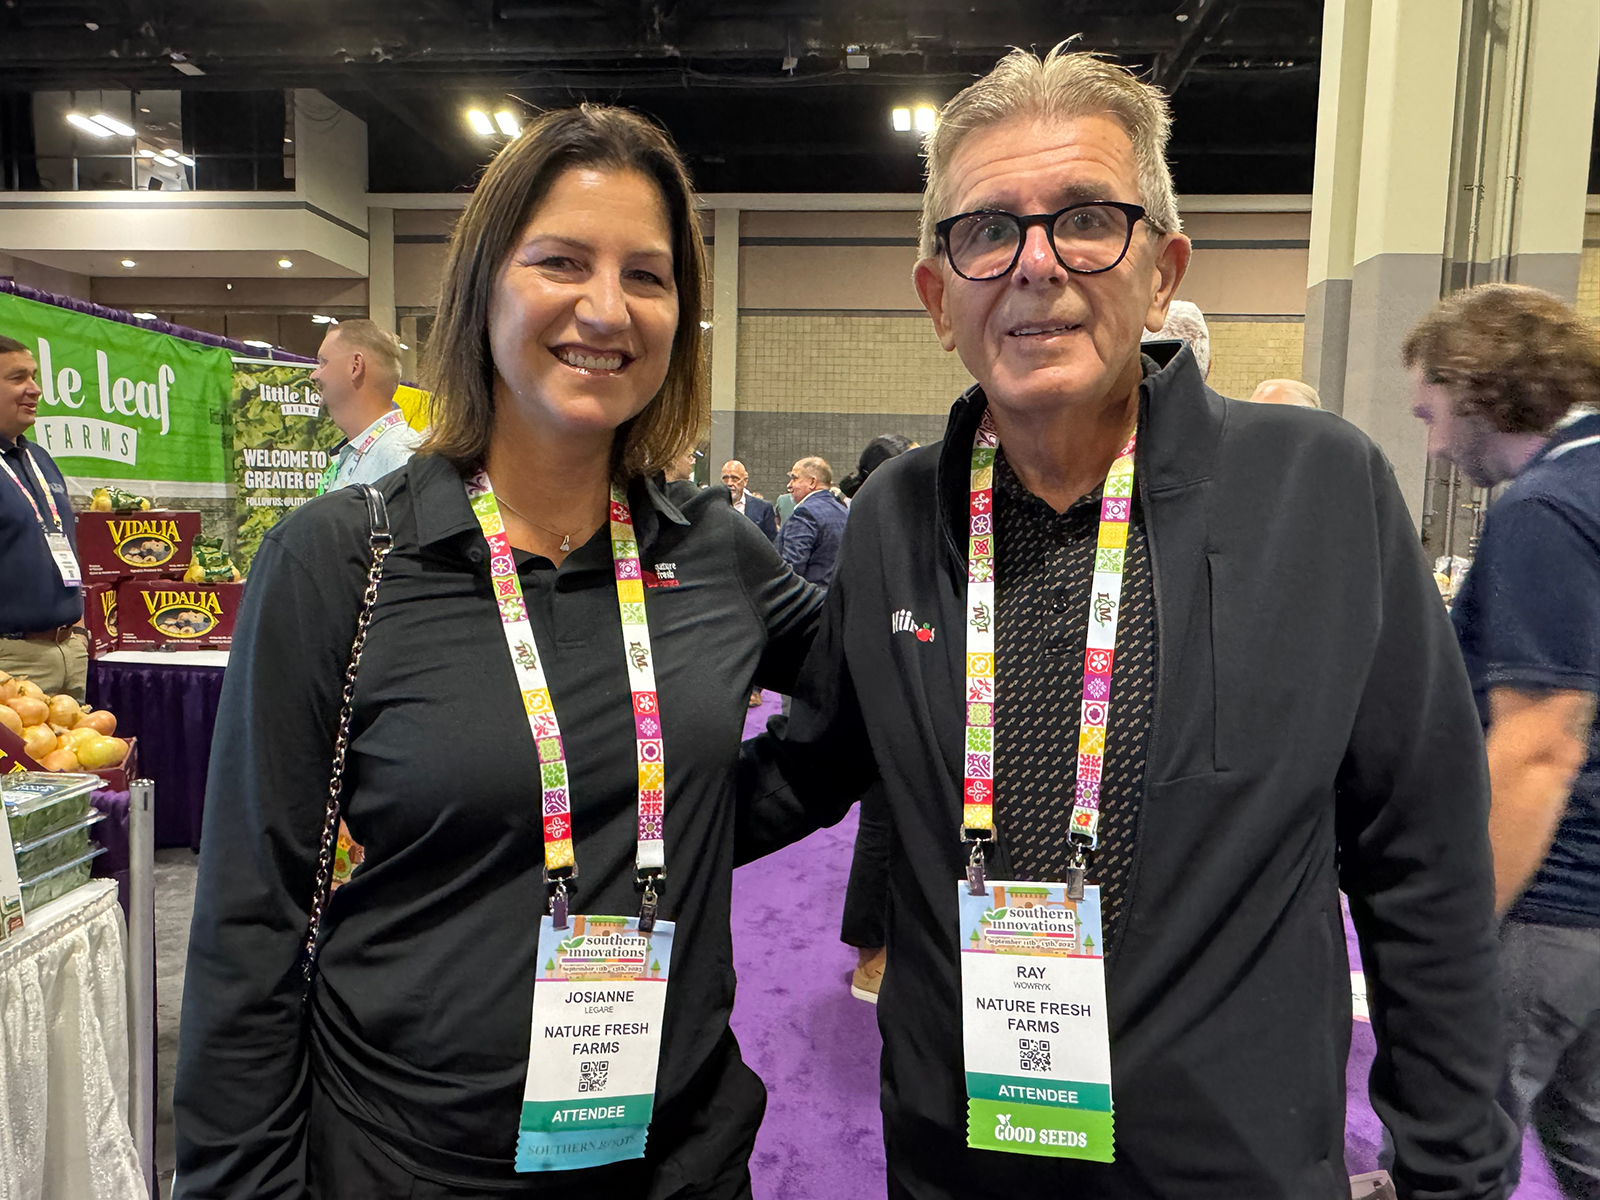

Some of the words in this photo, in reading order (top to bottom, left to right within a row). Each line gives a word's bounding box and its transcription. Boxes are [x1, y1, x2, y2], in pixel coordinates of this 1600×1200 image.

[97, 349, 175, 436] leaf
[259, 384, 300, 403] little
[305, 386, 322, 405] le
[44, 423, 129, 456] FARMS
[243, 449, 309, 468] WELCOME
[310, 451, 327, 469] TO
[244, 471, 304, 489] GREATER
[106, 520, 182, 545] VIDALIA
[140, 590, 223, 615] VIDALIA
[1009, 907, 1074, 920] southern
[993, 920, 1074, 932] innovations
[585, 934, 646, 946] southern
[568, 946, 645, 957] innovations
[1017, 965, 1046, 979] RAY
[1013, 981, 1051, 991] WOWRYK
[564, 990, 634, 1004] JOSIANNE
[584, 1005, 614, 1014] LEGARE
[976, 997, 1036, 1014] NATURE
[1040, 1002, 1091, 1017] FRESH
[544, 1024, 601, 1039] NATURE
[604, 1022, 649, 1036] FRESH
[1007, 1018, 1060, 1034] FARMS
[572, 1041, 620, 1056] FARMS
[998, 1084, 1079, 1104] ATTENDEE
[551, 1105, 625, 1123] ATTENDEE
[994, 1123, 1036, 1144] GOOD
[1039, 1128, 1088, 1148] SEEDS
